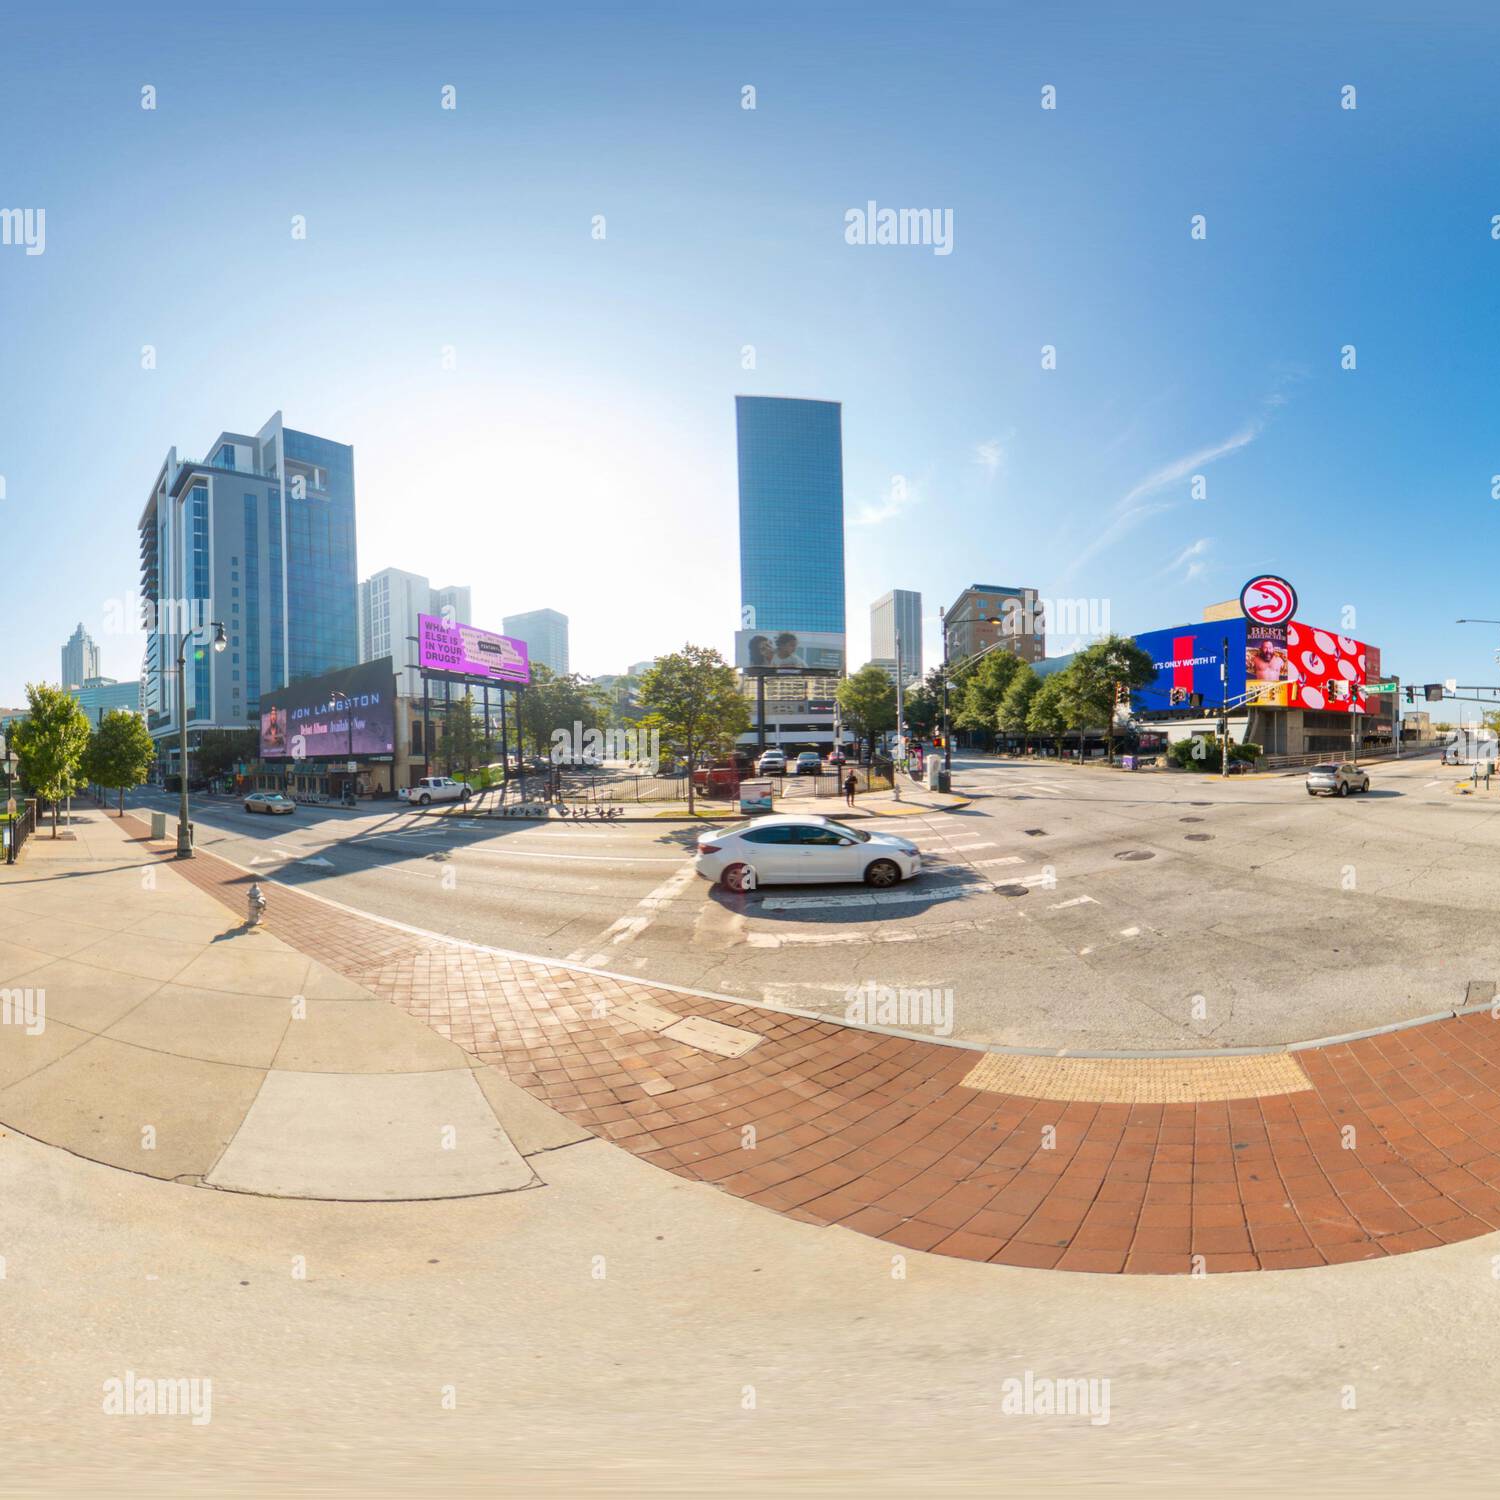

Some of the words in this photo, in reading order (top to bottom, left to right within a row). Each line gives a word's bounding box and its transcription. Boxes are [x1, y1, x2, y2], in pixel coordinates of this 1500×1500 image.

[1251, 627, 1284, 636] BERT
[425, 632, 448, 643] ELSE
[450, 638, 459, 646] IS
[425, 641, 436, 651] IN
[438, 644, 462, 656] YOUR
[426, 651, 461, 665] DRUGS?
[1164, 660, 1181, 669] ONLY
[1182, 657, 1208, 667] WORTH
[1209, 656, 1217, 664] IT
[291, 707, 310, 721] JON
[314, 693, 380, 716] LANGSTON
